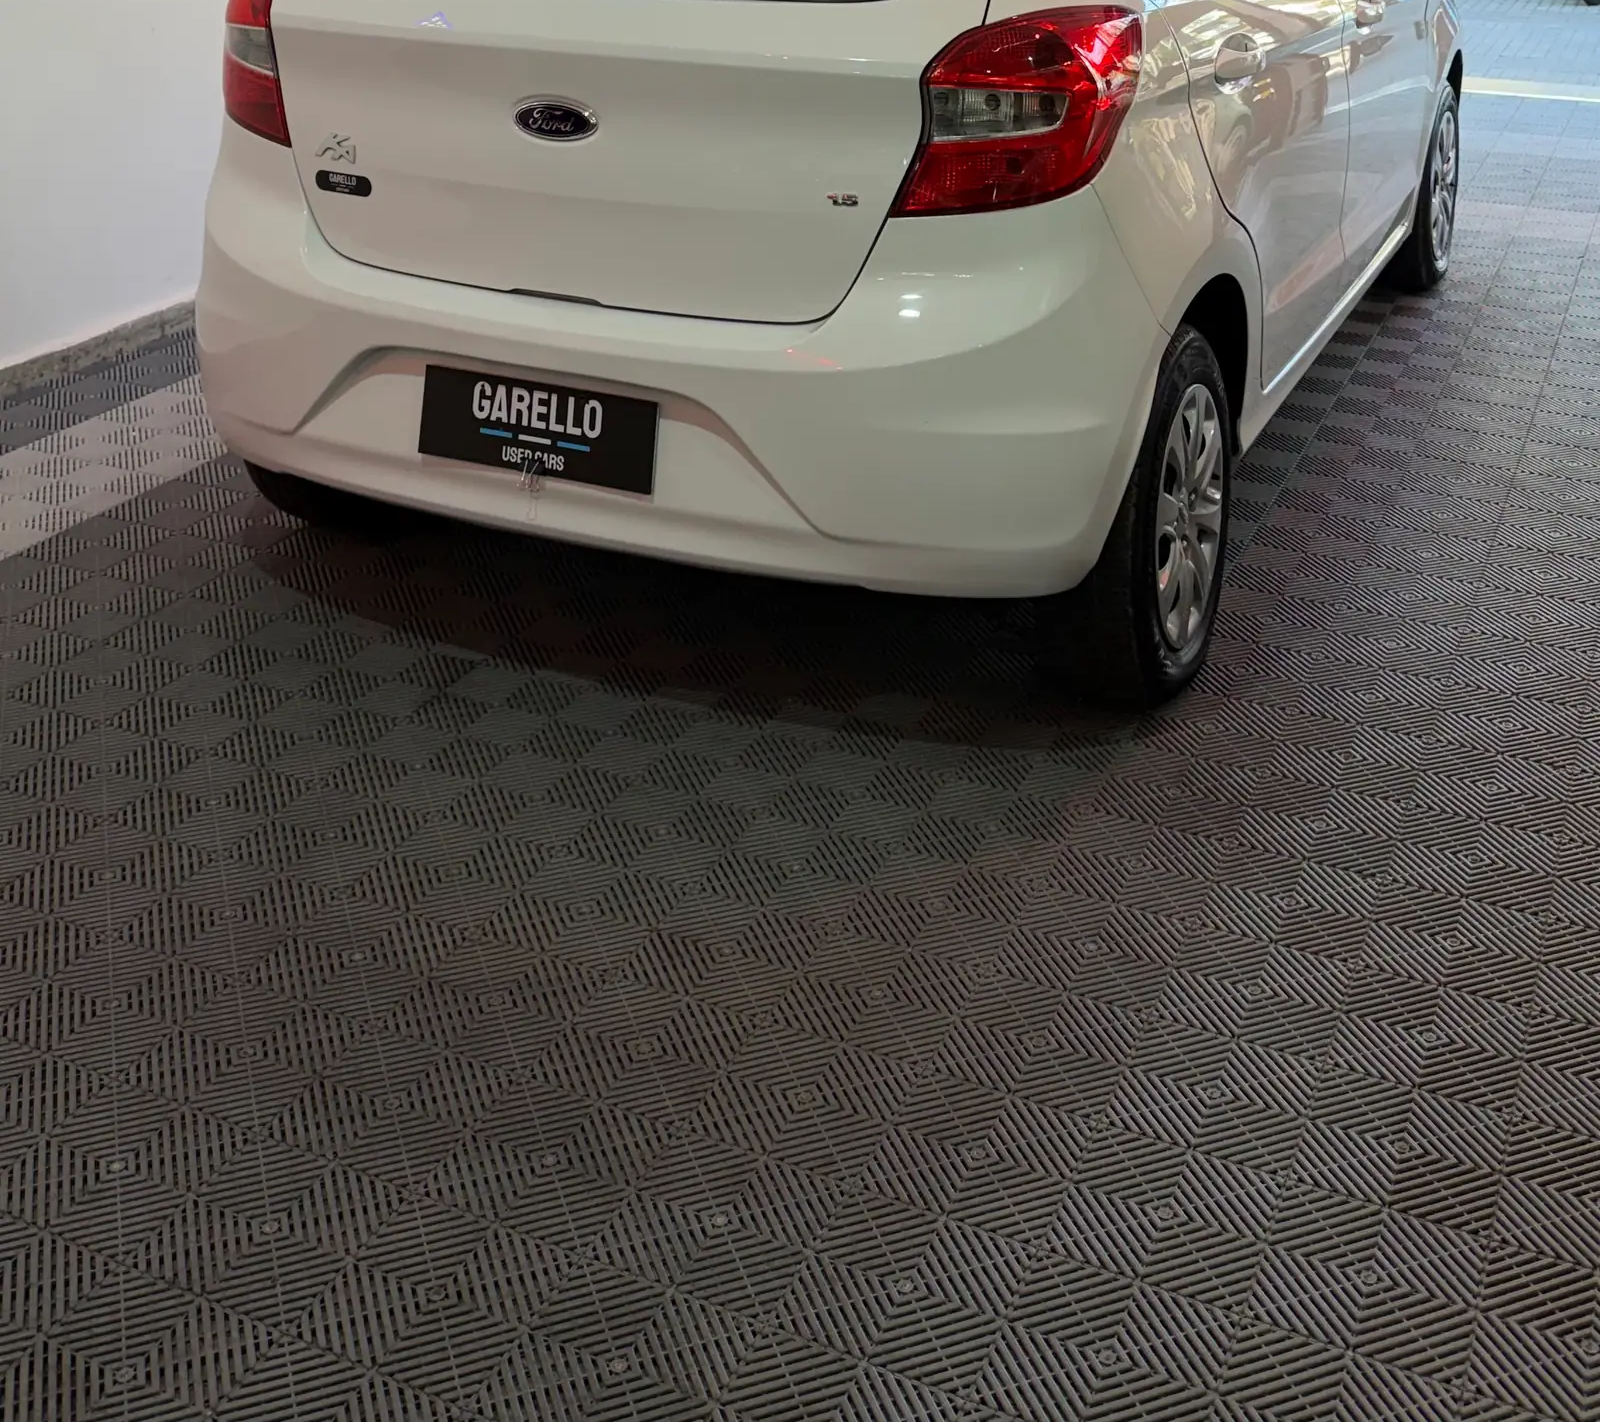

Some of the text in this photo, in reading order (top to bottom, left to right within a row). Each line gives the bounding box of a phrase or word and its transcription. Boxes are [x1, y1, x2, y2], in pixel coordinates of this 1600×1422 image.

[528, 107, 575, 132] Ford
[328, 172, 357, 186] GARELLO
[472, 381, 603, 439] GARELLO
